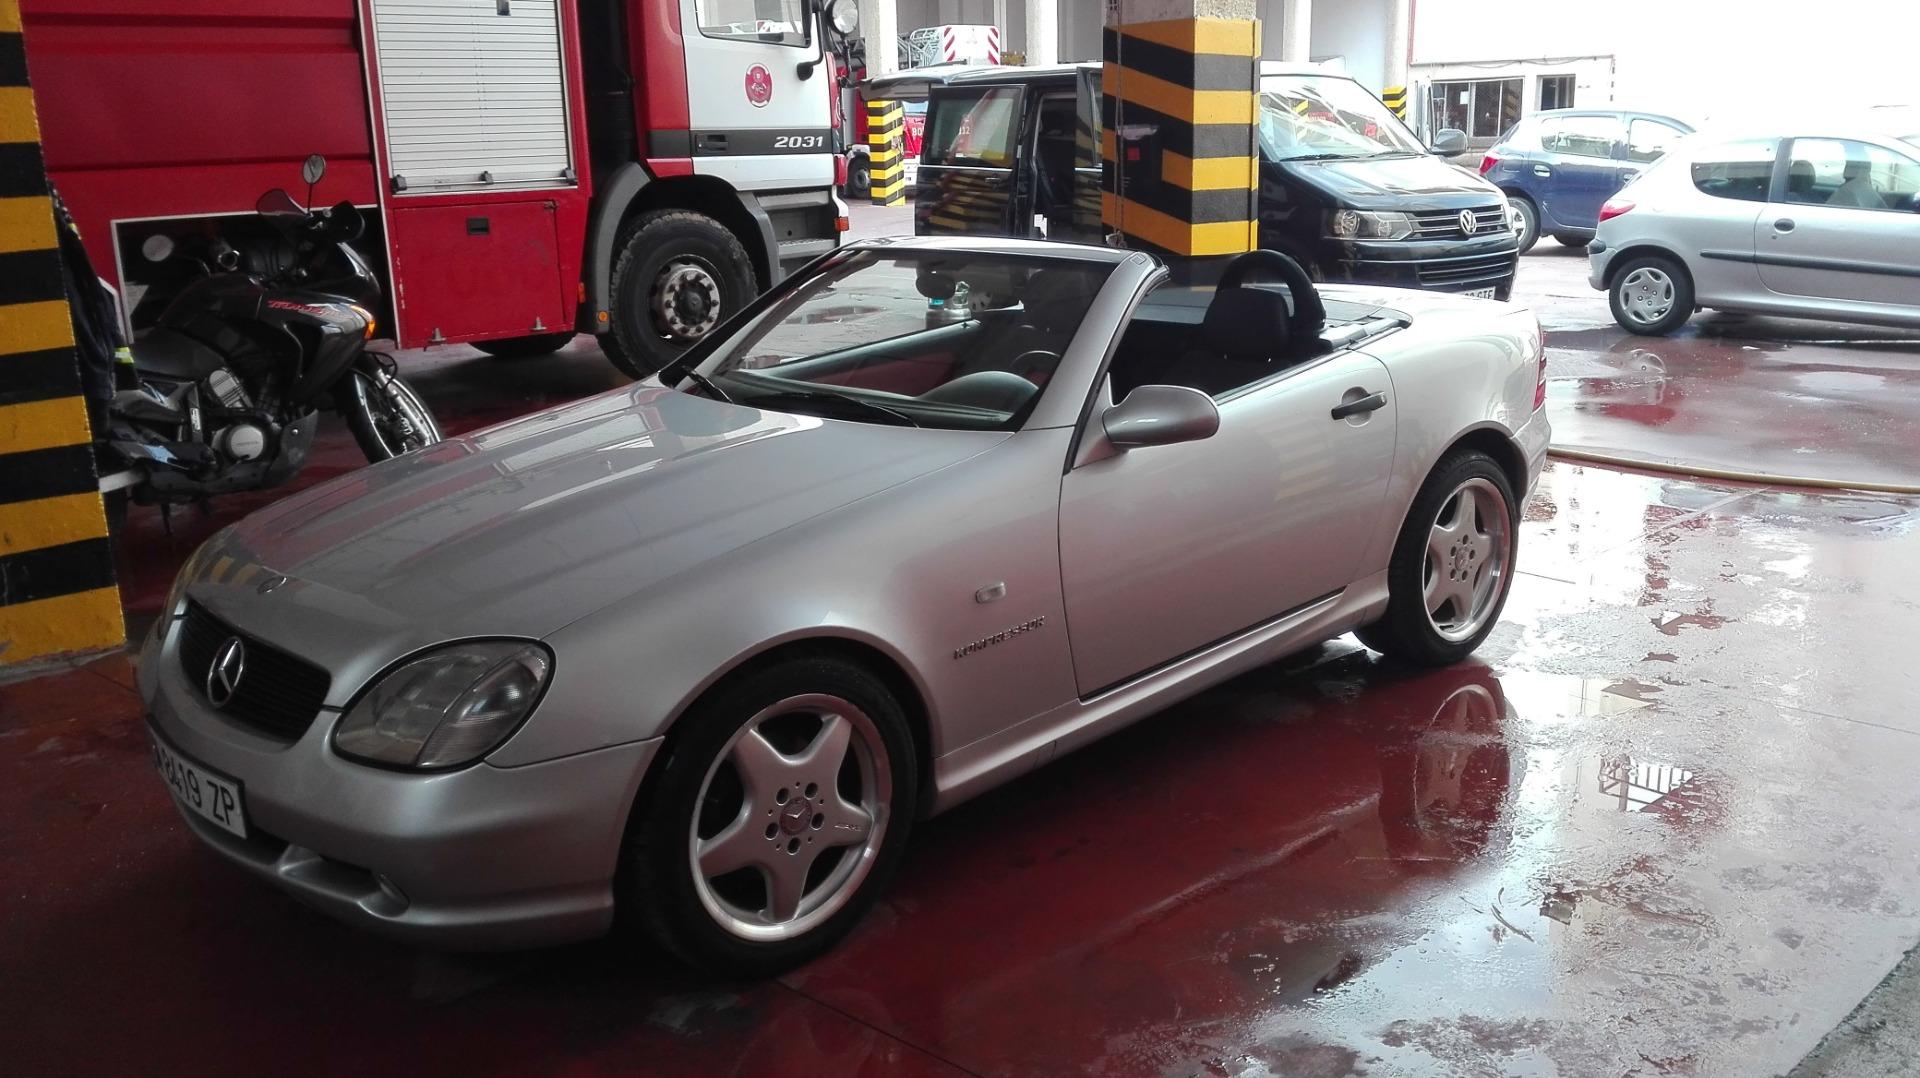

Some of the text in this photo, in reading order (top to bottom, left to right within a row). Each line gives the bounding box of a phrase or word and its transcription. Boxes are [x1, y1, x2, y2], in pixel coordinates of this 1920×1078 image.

[774, 135, 823, 148] 2031
[953, 615, 1045, 660] KOMPRESSOR
[206, 779, 235, 826] ZP
